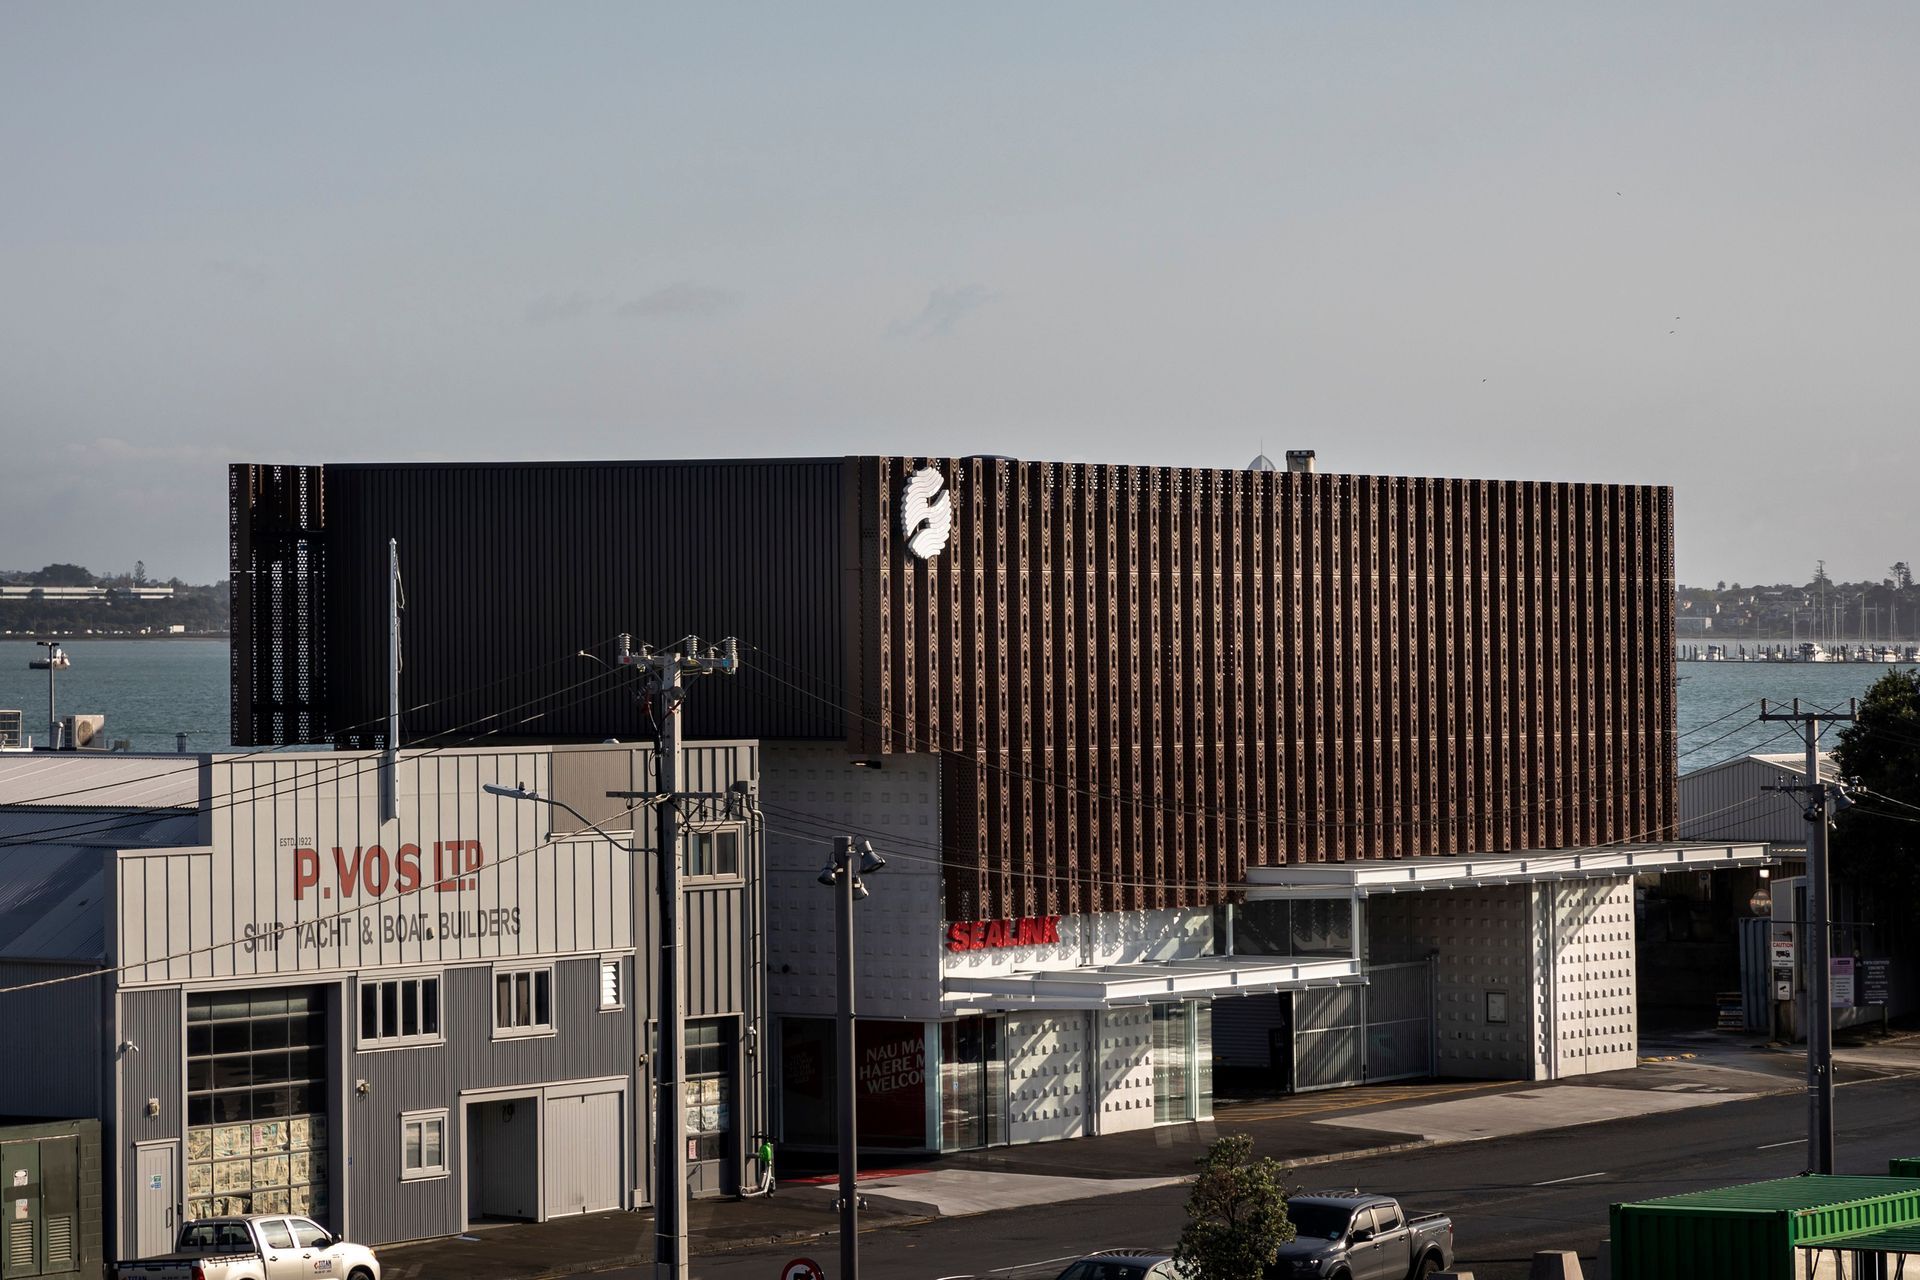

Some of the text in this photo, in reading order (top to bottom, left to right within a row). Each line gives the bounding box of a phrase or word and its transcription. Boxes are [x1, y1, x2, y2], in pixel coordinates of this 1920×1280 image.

[298, 836, 312, 846] 1922
[243, 907, 521, 953] SHIP YACHT & BOAT BUILDERS
[946, 916, 1060, 952] SEALINK
[867, 1043, 897, 1062] NAU
[859, 1056, 913, 1081] HAERE
